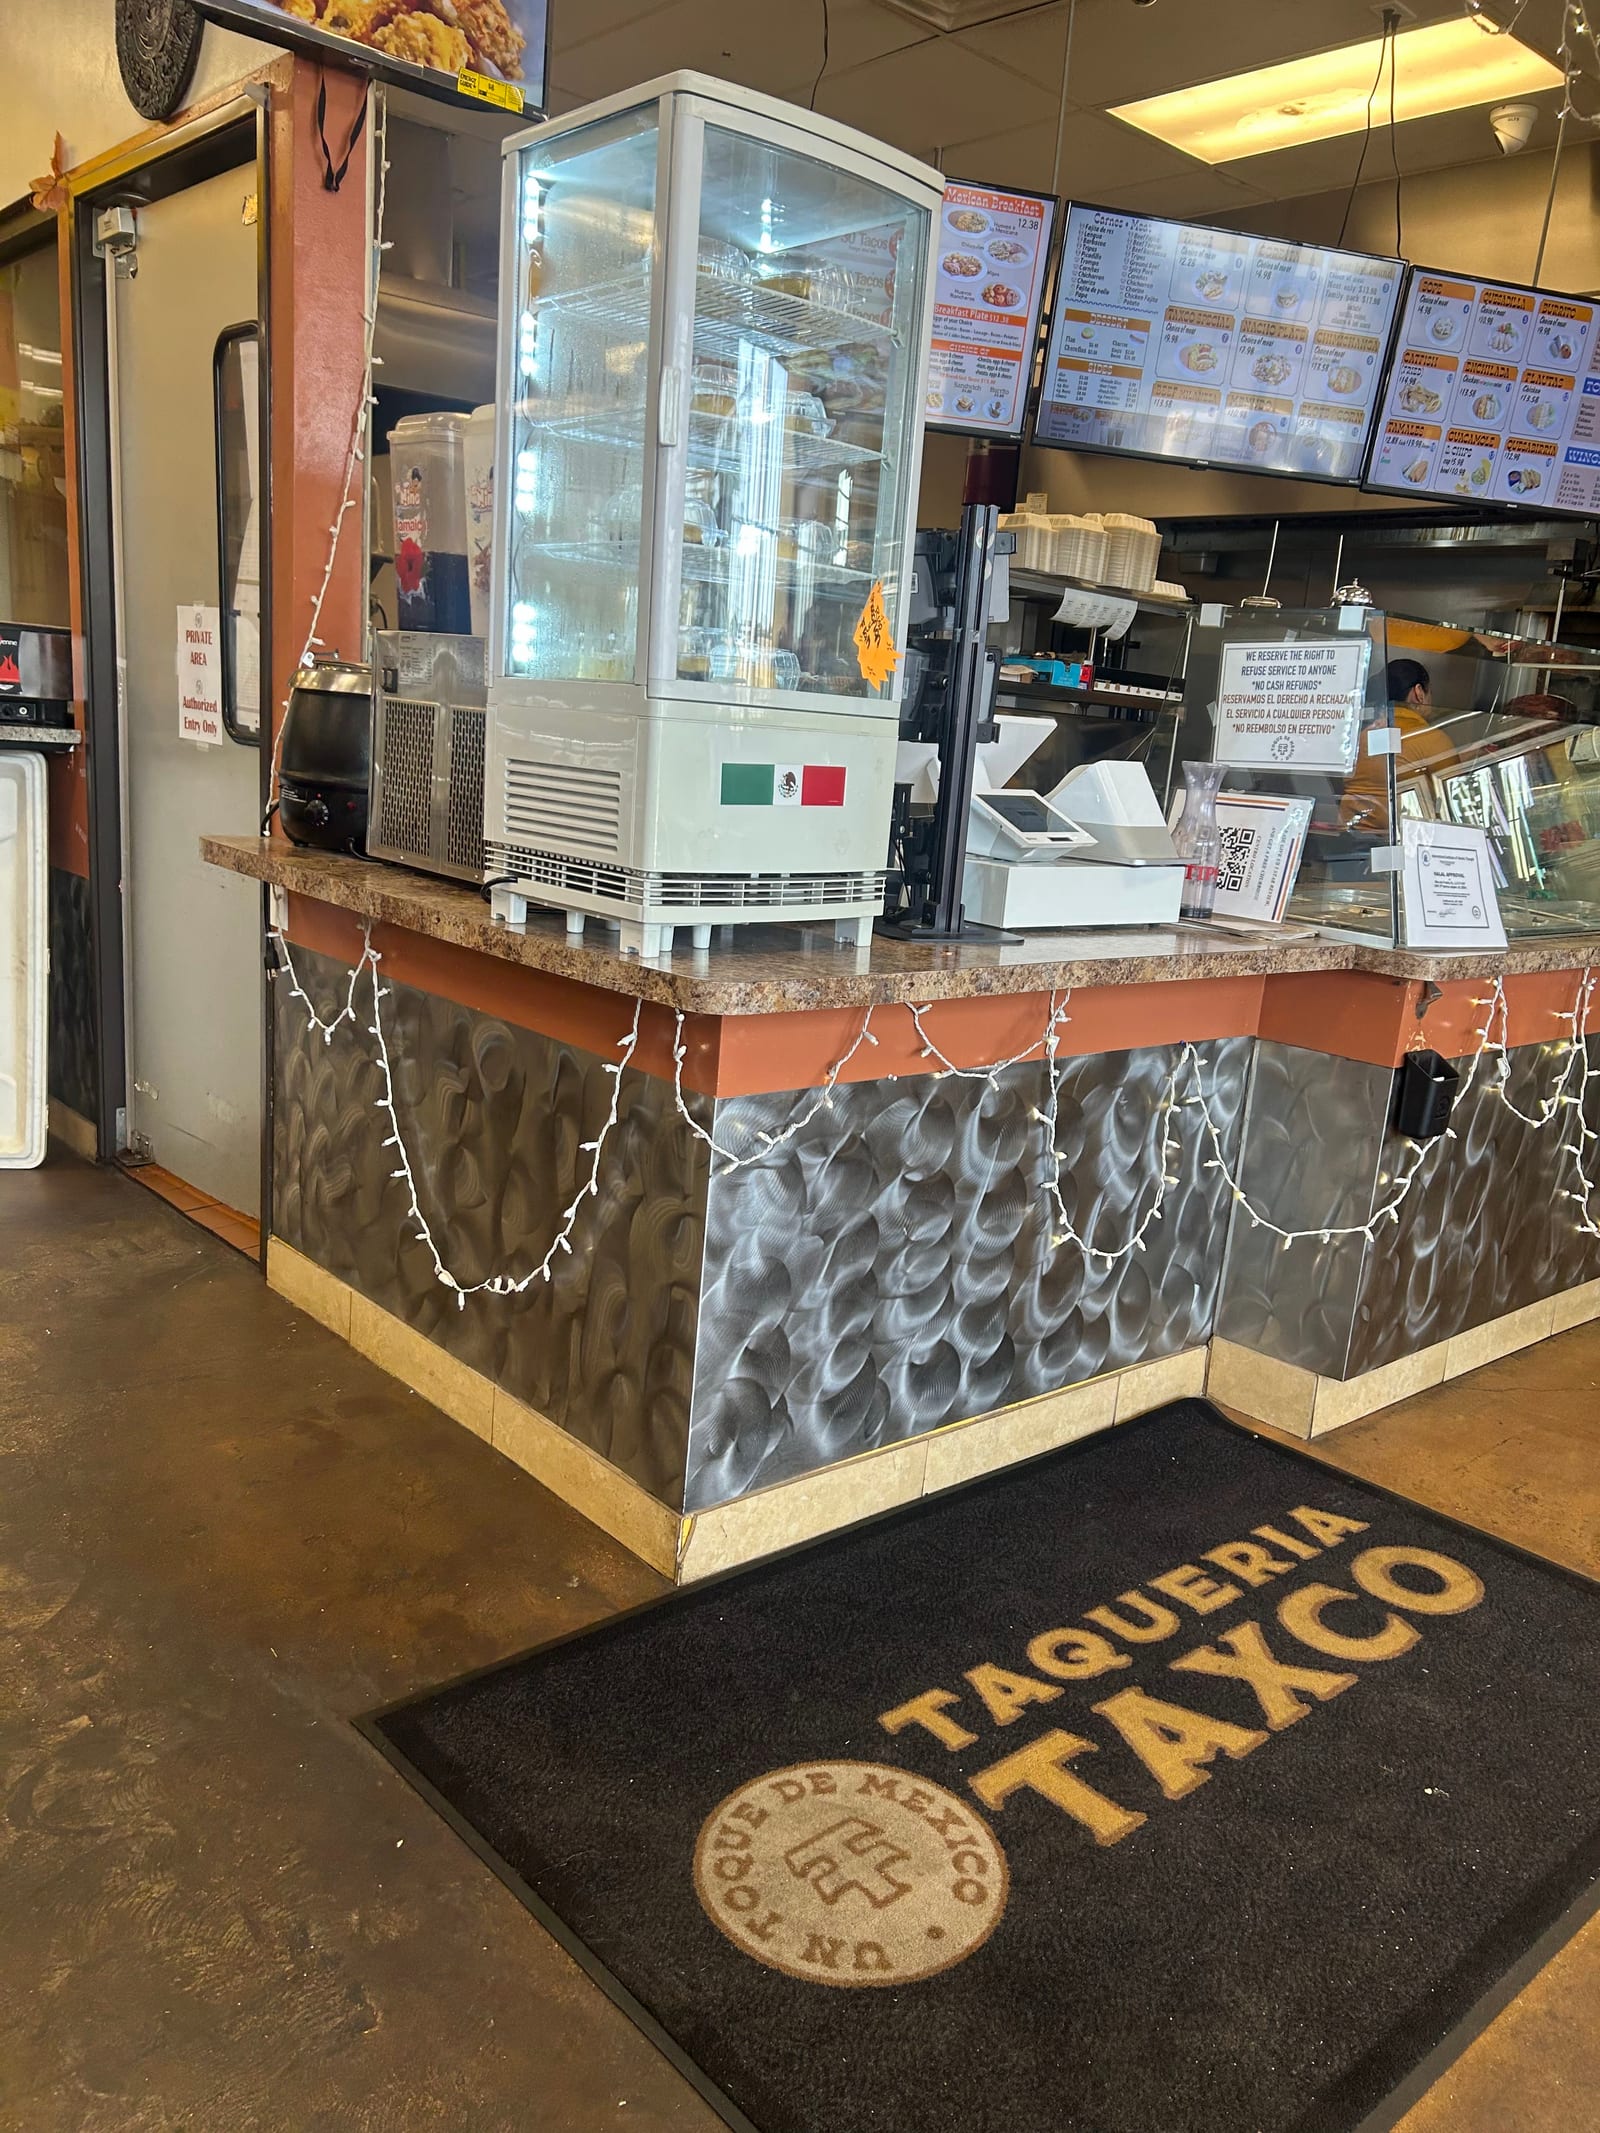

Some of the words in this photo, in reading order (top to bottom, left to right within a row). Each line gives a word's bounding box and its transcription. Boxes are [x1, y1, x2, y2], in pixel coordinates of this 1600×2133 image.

[946, 188, 989, 207] Mexican
[991, 196, 1040, 217] Breakfast
[1018, 218, 1039, 231] 12.38
[1094, 212, 1124, 228] Carnes
[1084, 230, 1103, 240] Lengua
[1081, 251, 1102, 260] Picadillo
[1421, 280, 1443, 295] SOPE
[934, 304, 969, 317] Breakfast
[970, 309, 989, 320] Plate
[1168, 307, 1196, 323] TAXCO
[1197, 312, 1231, 330] SPECIAL
[1540, 302, 1578, 319] BURRITO
[1090, 313, 1129, 329] DESSERT
[1241, 319, 1276, 336] NACHO
[1404, 352, 1439, 368] CATFISH
[1088, 362, 1113, 375] SIDES
[1464, 361, 1511, 379] ENCHILADA
[1524, 372, 1565, 389] FLAUTAS
[1388, 421, 1425, 438] TAMALES
[1448, 431, 1496, 448] GUACAMOLE
[1451, 446, 1473, 458] CHIPS
[186, 630, 213, 646] PRIVATE
[190, 651, 207, 666] AREA
[1246, 651, 1256, 661] WE
[1257, 651, 1288, 661] RESERVE
[1289, 651, 1303, 660] THE
[1303, 650, 1325, 660] RIGHT
[1326, 649, 1335, 659] TO
[1241, 666, 1267, 676] REFUSE
[1268, 666, 1297, 676] SERVICE
[1298, 665, 1307, 675] TO
[1308, 665, 1337, 675] ANYONE
[1266, 681, 1284, 690] CASH
[183, 696, 218, 713] Authorized
[1223, 694, 1265, 704] RESERVAMOS
[1267, 695, 1275, 704] EL
[1277, 695, 1308, 704] DERECHO
[1309, 695, 1315, 704] A
[1226, 709, 1234, 719] EL
[1235, 709, 1265, 719] SERVICIO
[1265, 710, 1272, 719] A
[1272, 710, 1311, 719] CUALQUIER
[1312, 710, 1346, 719] PERSONA
[184, 716, 201, 735] Entry
[202, 720, 217, 737] Only
[1246, 724, 1286, 734] REEMBOLSO
[1287, 724, 1297, 734] EN
[877, 1505, 1371, 1752] TAQUERIA
[968, 1545, 1486, 1847] TAXCO
[769, 1771, 838, 1804] DE
[856, 1773, 990, 1905] MEXICO
[713, 1802, 784, 1941] TOQUE
[799, 1935, 894, 1970] UN
